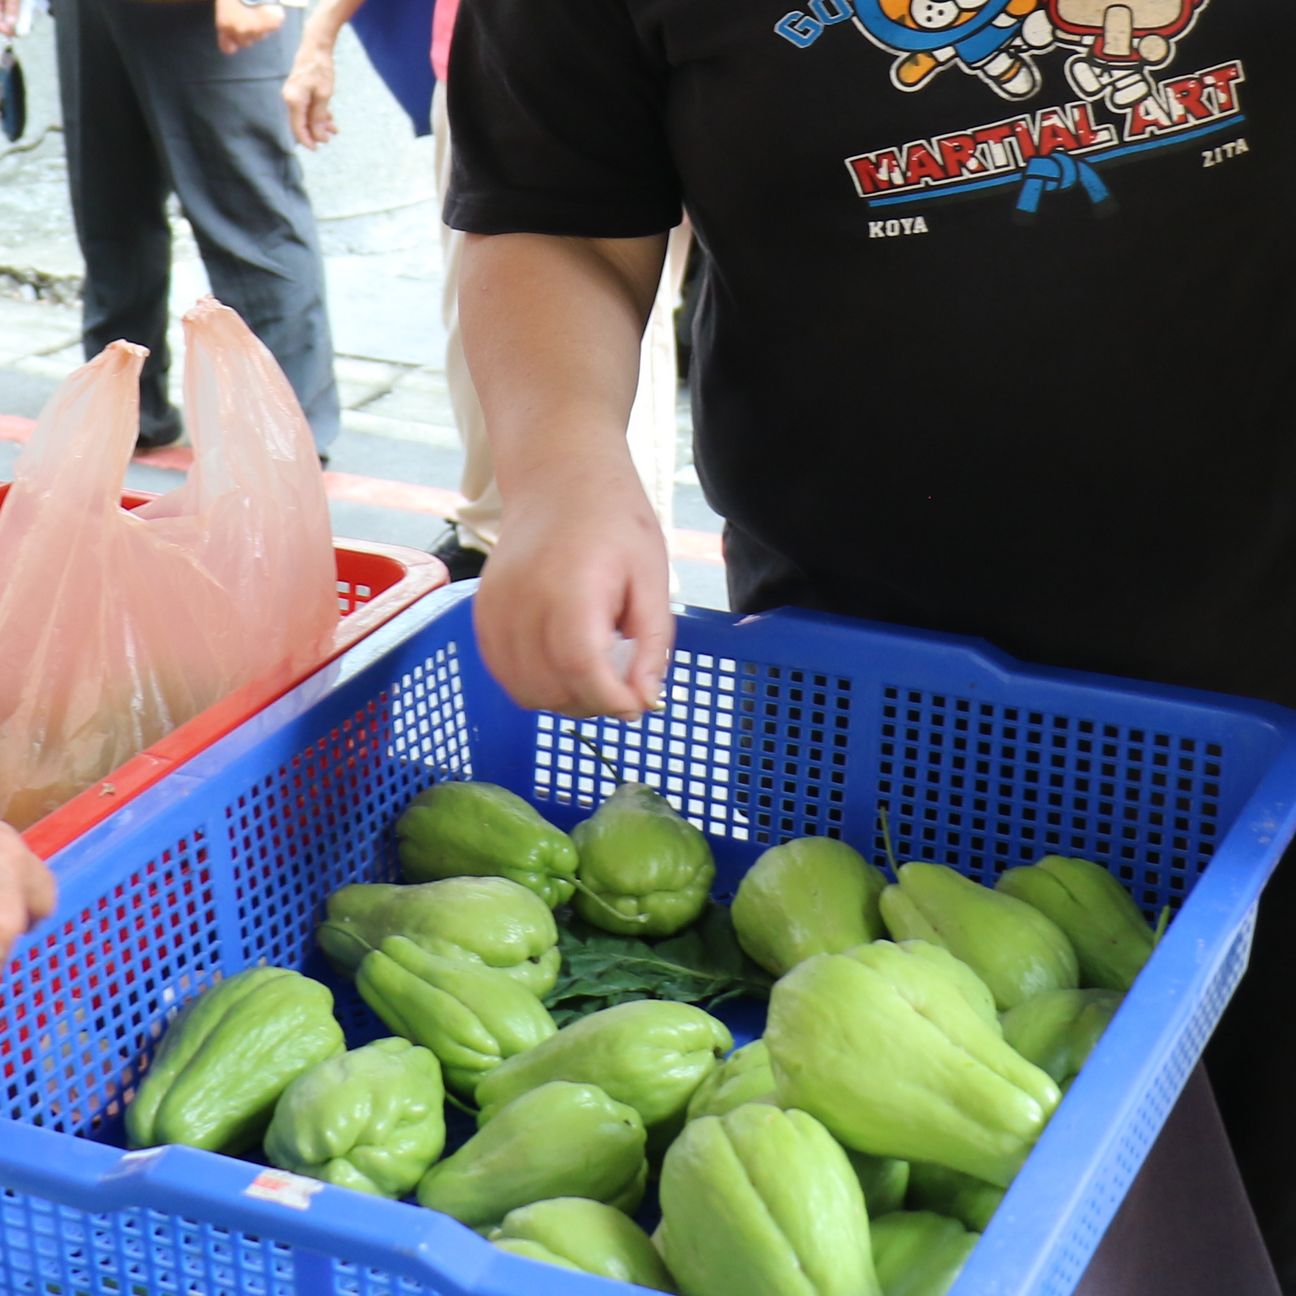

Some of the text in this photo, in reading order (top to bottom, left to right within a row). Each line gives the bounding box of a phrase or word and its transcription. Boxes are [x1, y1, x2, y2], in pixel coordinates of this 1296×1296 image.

[845, 60, 1245, 198] MARTIAL ART
[1201, 138, 1250, 168] ZITA
[868, 215, 929, 240] KOYA
